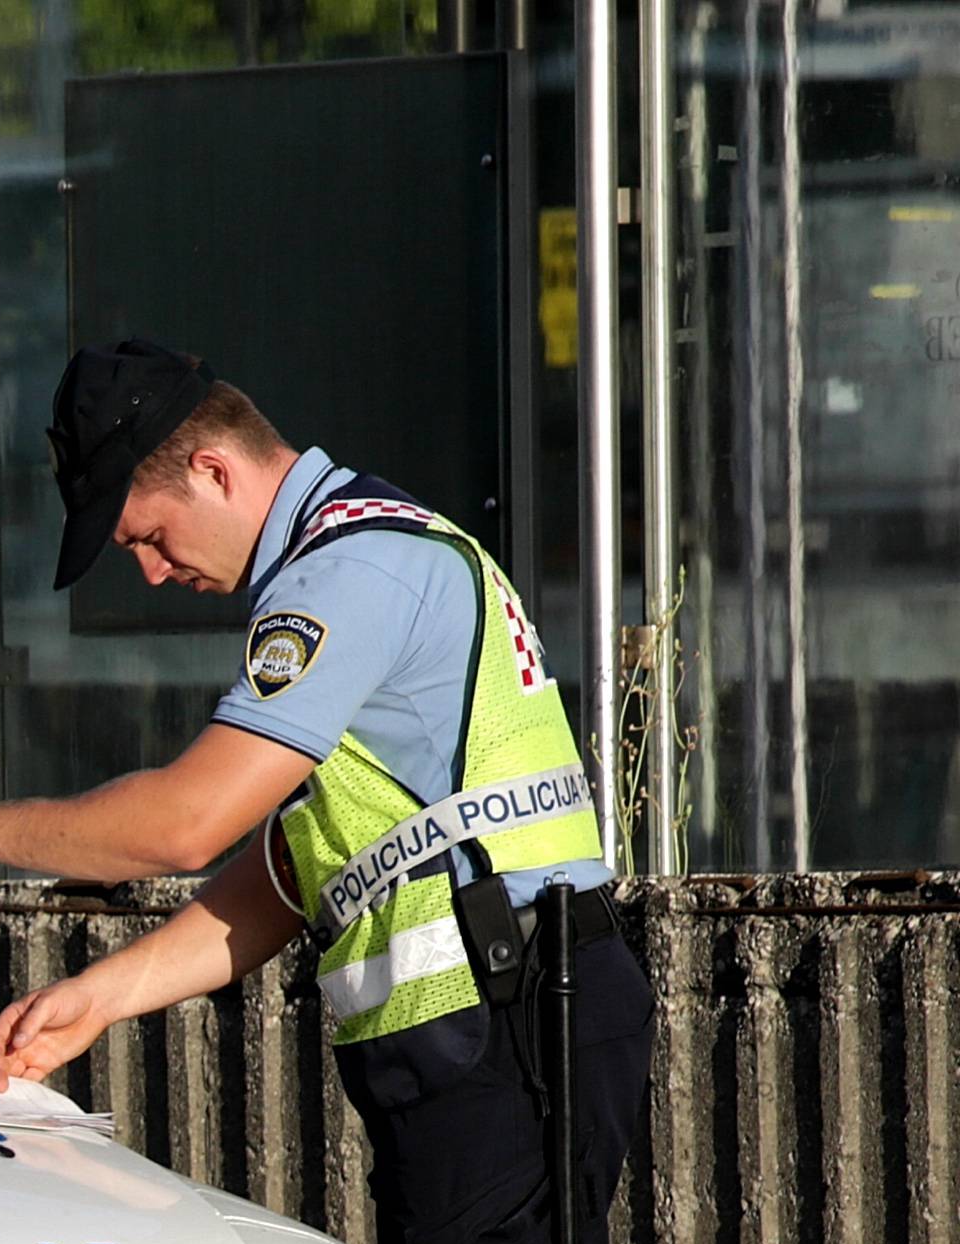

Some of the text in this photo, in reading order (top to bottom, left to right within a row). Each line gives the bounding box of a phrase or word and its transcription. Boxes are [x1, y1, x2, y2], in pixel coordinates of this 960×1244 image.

[258, 617, 321, 641] POLICIJA
[267, 645, 295, 662] RH
[261, 662, 291, 673] MUP
[330, 775, 582, 917] POLICIJA POLICIJA
